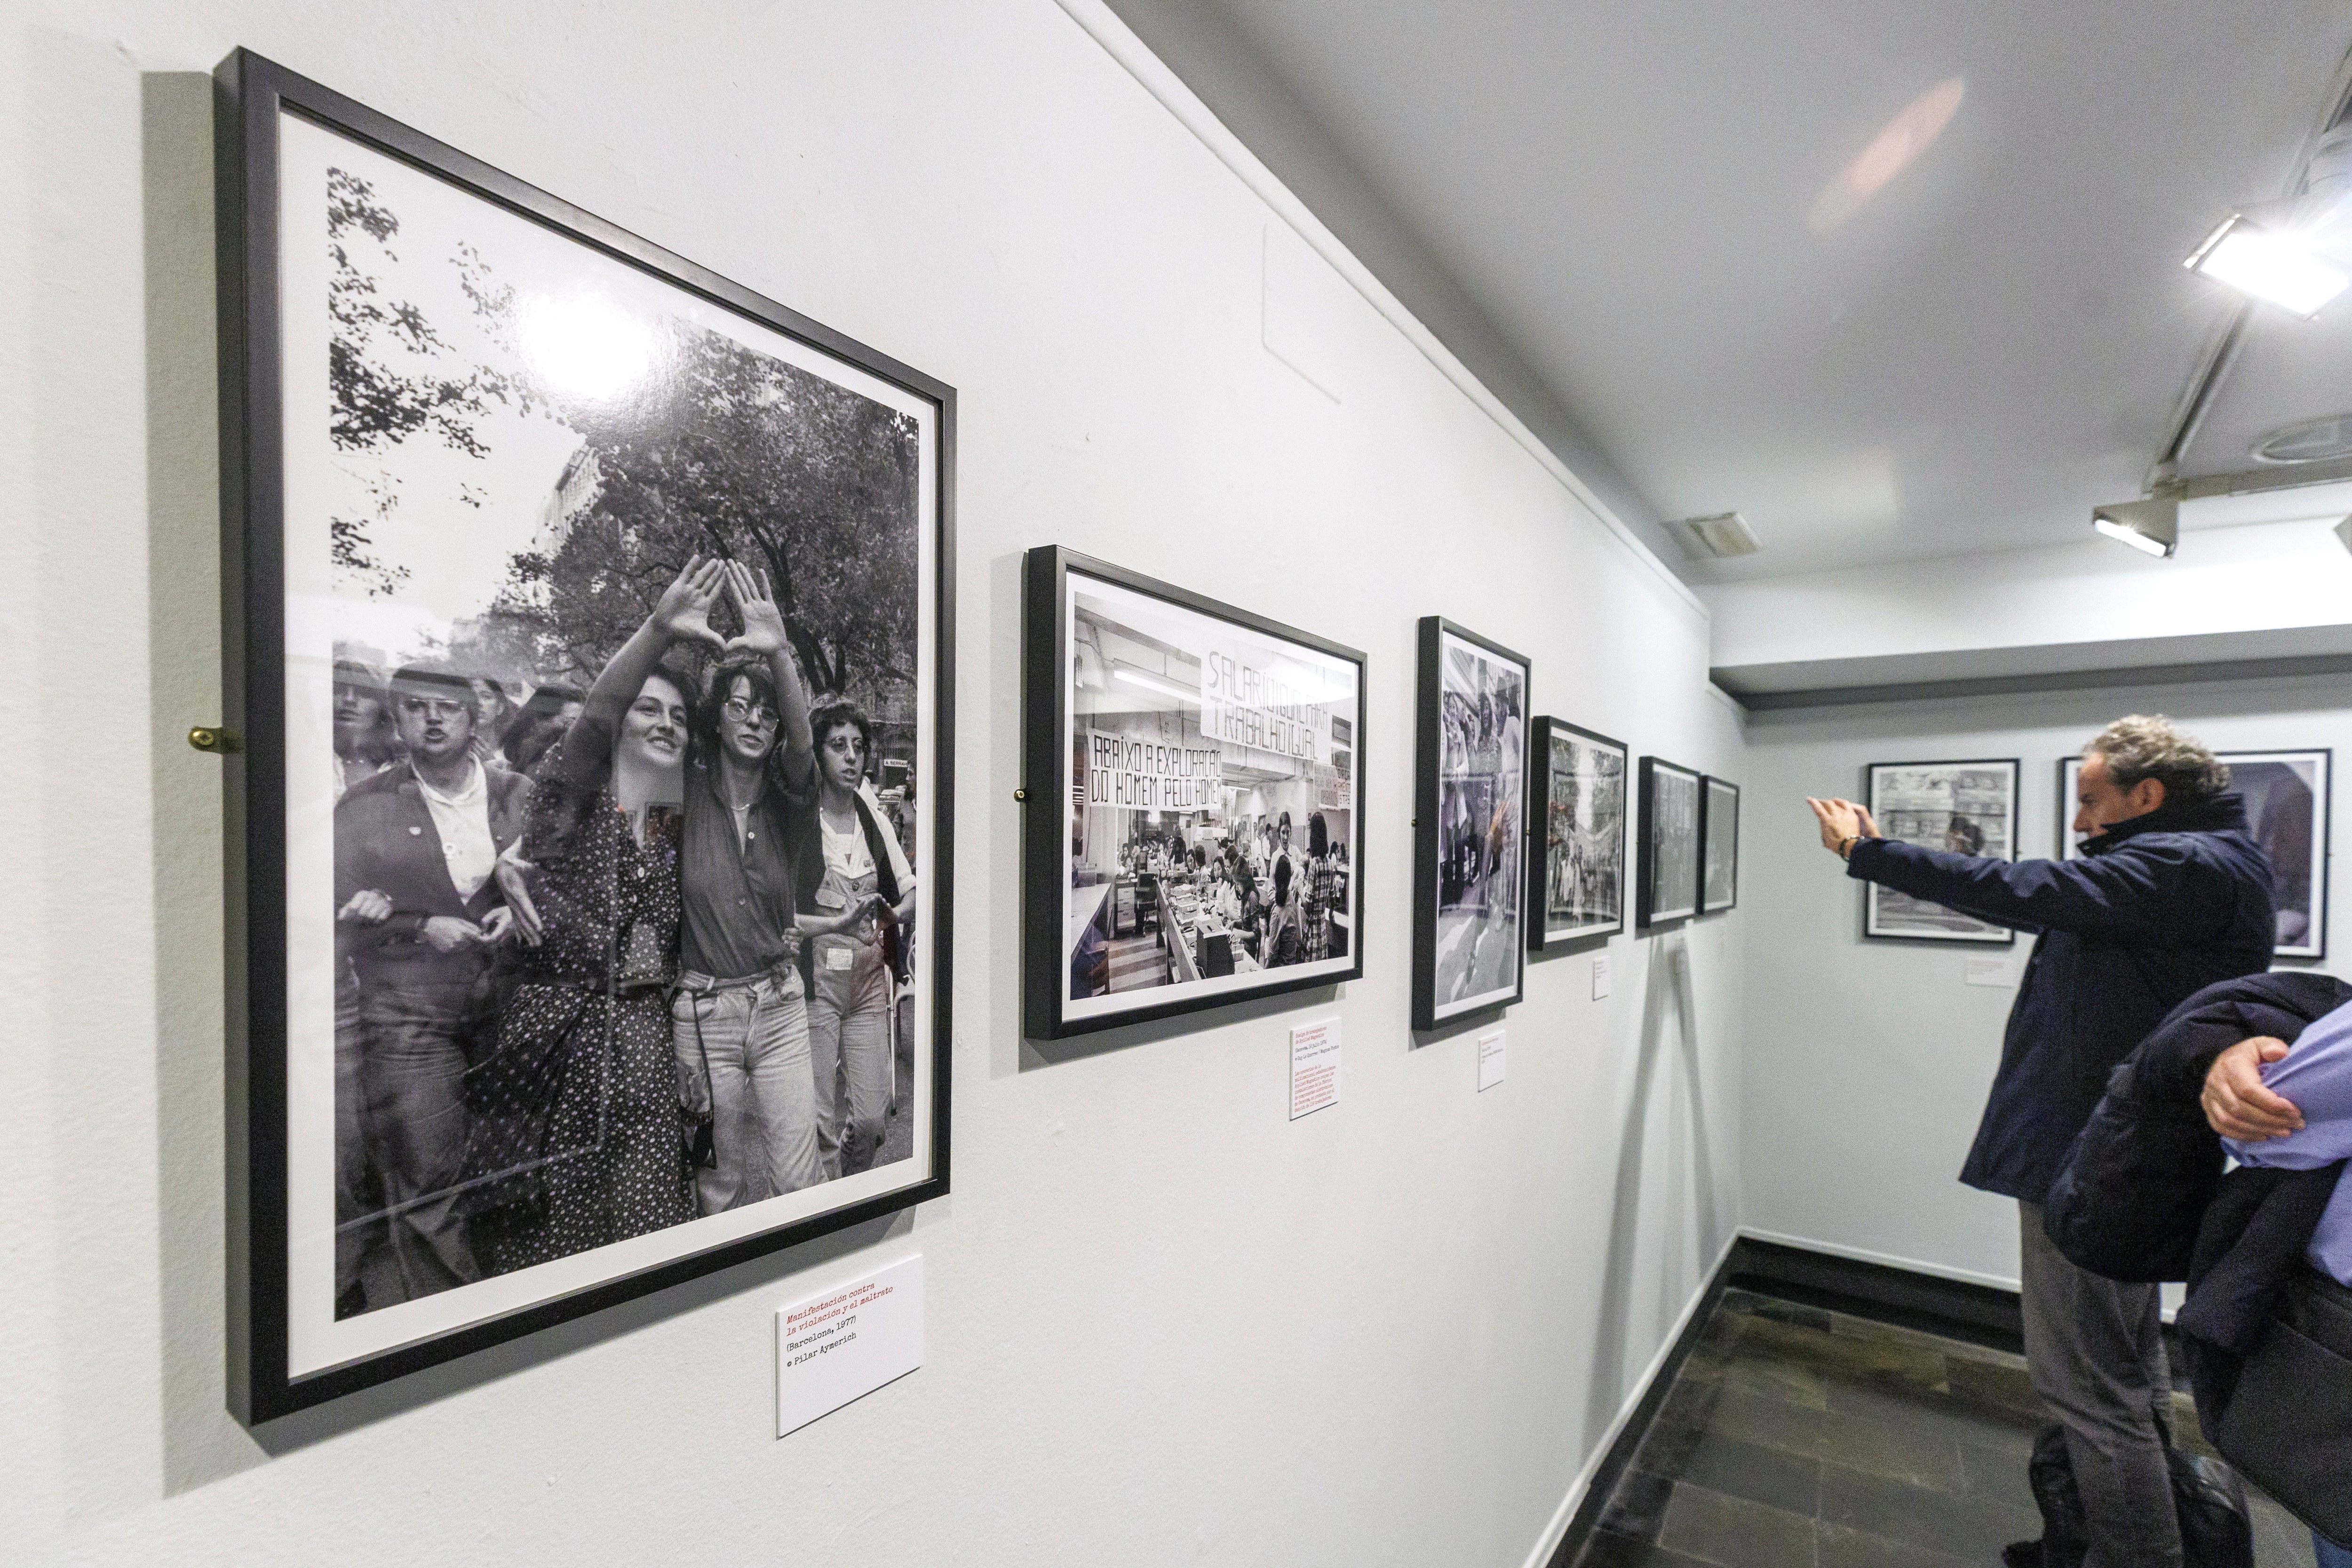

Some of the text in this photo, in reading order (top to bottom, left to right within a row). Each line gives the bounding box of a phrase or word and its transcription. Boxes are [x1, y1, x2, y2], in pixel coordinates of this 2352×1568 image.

[1209, 696, 1286, 753] TRABALHO
[1288, 722, 1319, 760] IGUAL
[1094, 735, 1222, 778] ABAIXO A EXPLORAÇÃO
[1091, 769, 1222, 807] DO HOMEM PELO HOMEM
[786, 1286, 893, 1336] la violación y el maltrato
[787, 1283, 874, 1324] Manifestación contra
[787, 1315, 856, 1352] (Barcelona, 1977)
[795, 1349, 818, 1365] Pilar
[820, 1332, 857, 1354] Aymerich
